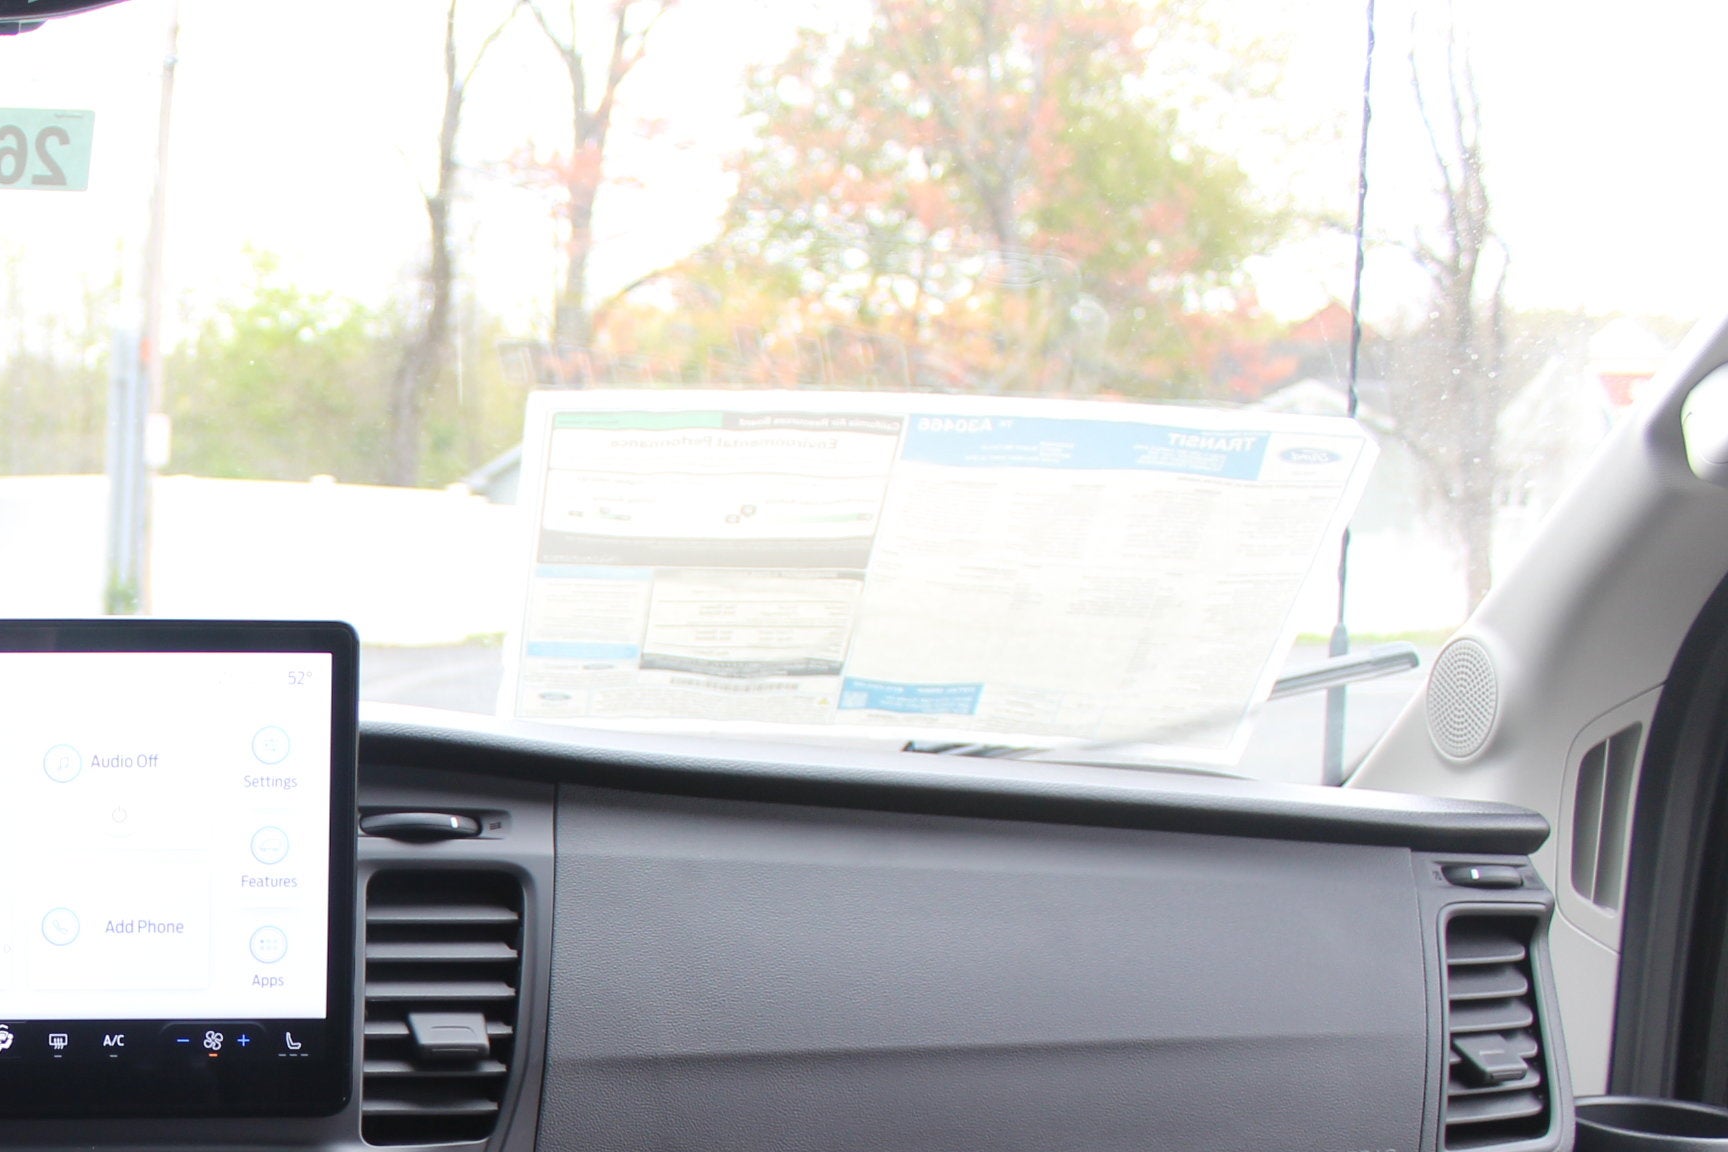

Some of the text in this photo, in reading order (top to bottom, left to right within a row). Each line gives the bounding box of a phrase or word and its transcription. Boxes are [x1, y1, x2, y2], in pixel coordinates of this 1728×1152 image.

[90, 753, 160, 769] Audio Off
[243, 774, 299, 790] Settings
[241, 875, 299, 888] Features
[105, 919, 185, 934] Add Phone
[251, 974, 285, 989] Apps
[103, 1034, 125, 1047] A/C
